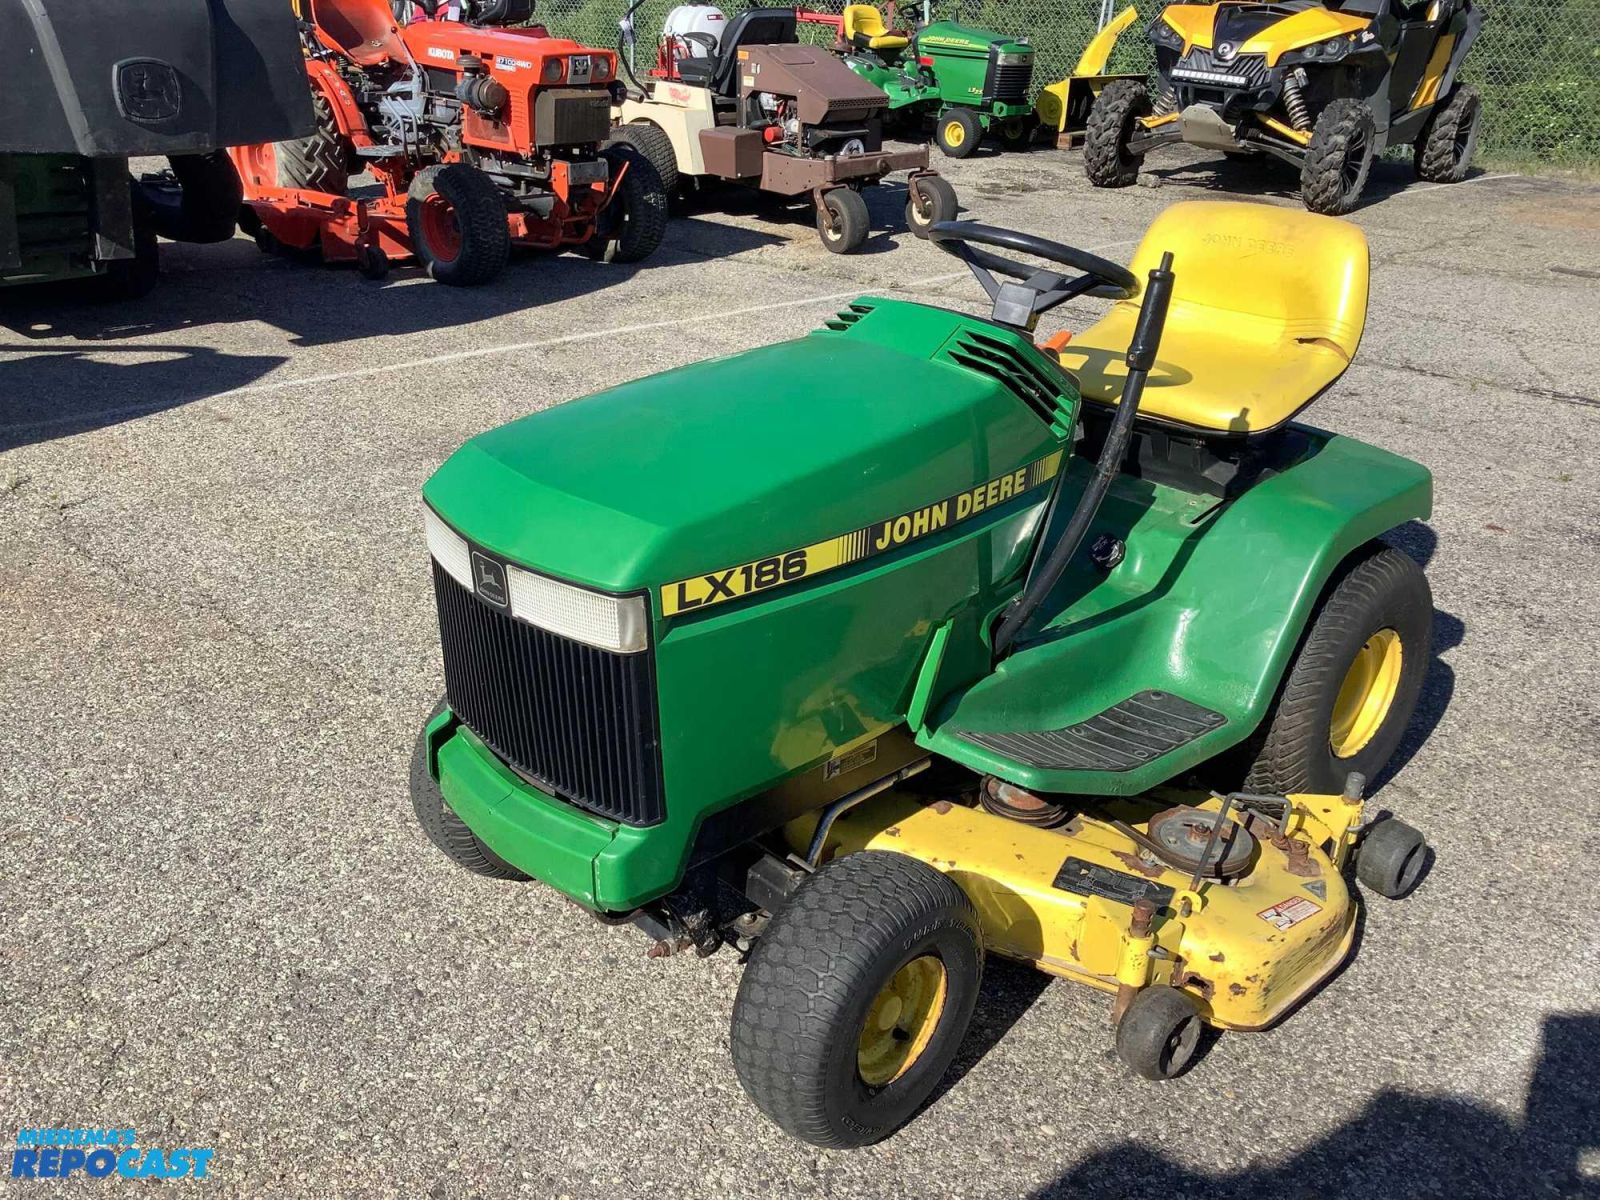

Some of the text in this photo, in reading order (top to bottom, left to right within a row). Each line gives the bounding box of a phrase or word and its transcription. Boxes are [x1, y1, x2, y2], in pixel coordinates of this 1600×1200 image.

[427, 47, 454, 60] KUBOTA
[876, 468, 1027, 550] JOHN DEERE
[677, 550, 808, 611] LX186
